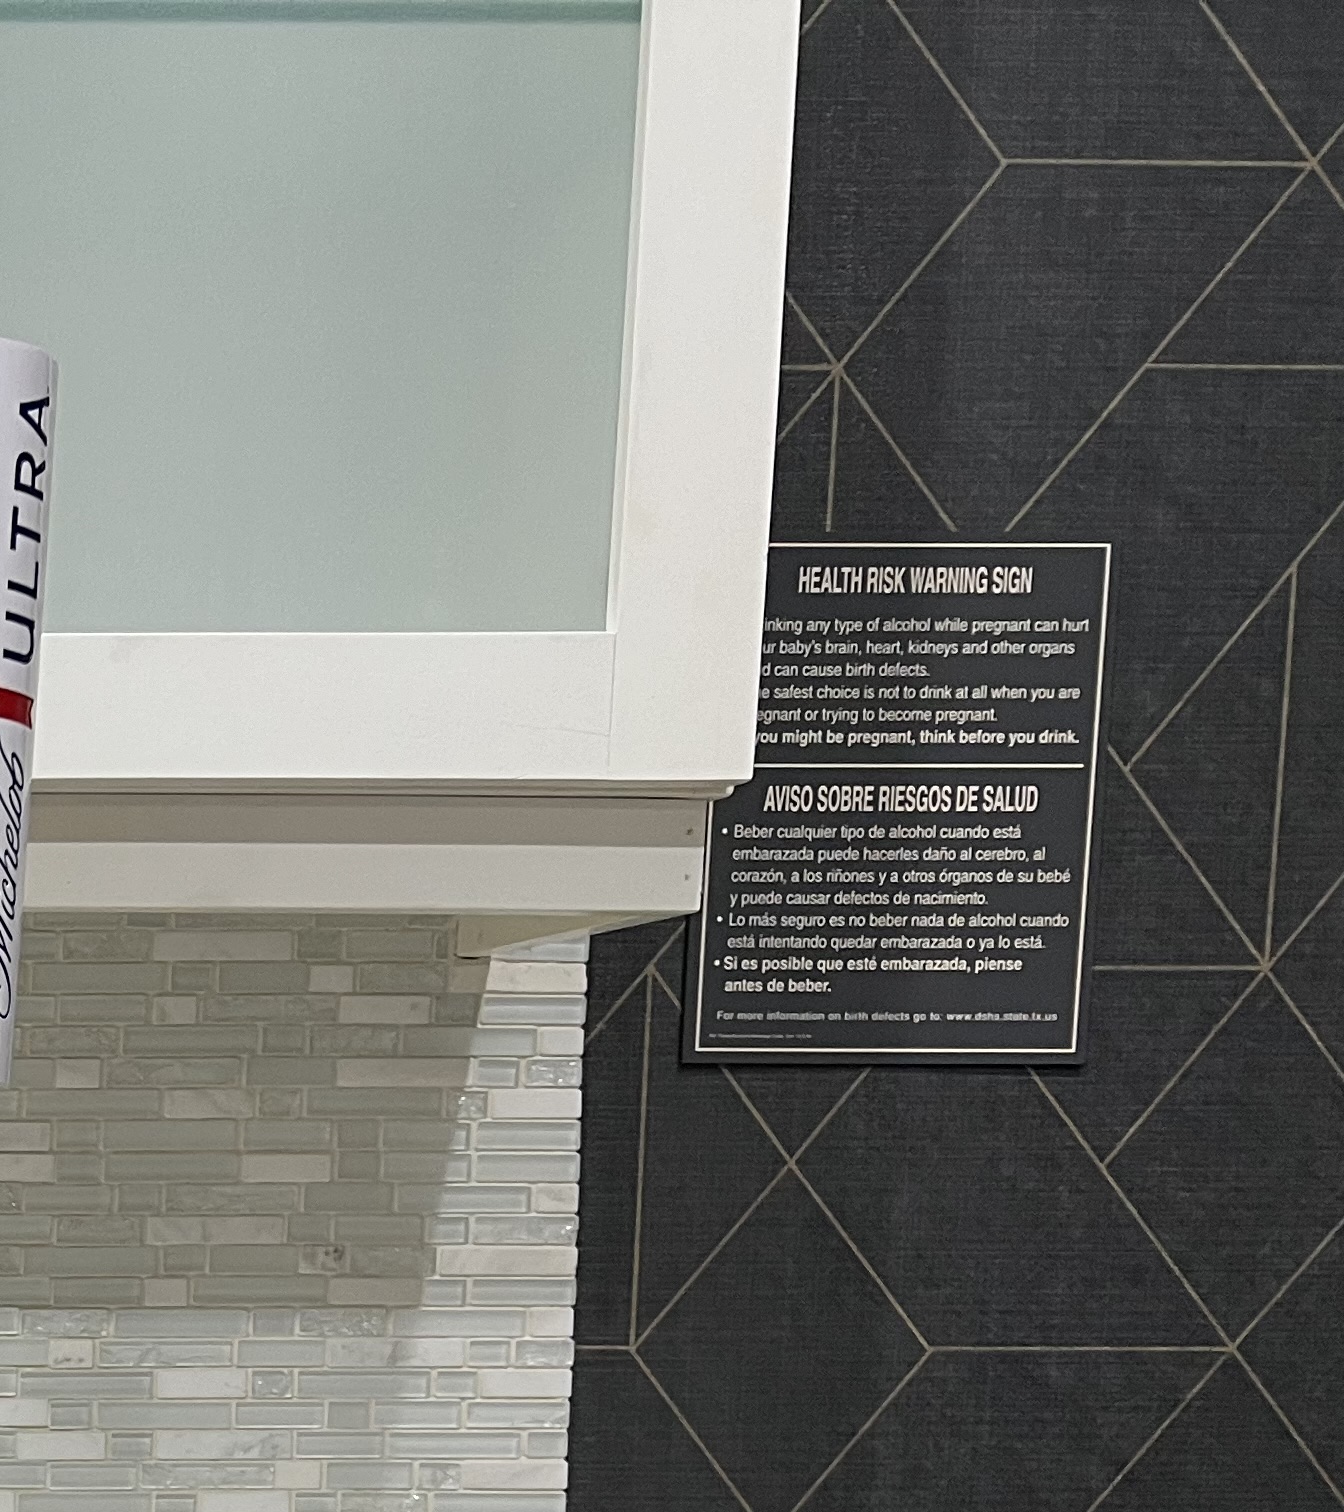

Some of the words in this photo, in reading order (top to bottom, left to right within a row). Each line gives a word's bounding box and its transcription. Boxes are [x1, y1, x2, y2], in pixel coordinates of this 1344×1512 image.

[2, 395, 51, 666] ULTRA
[798, 566, 862, 593] HEALTH
[866, 567, 906, 593] RISK
[910, 567, 988, 593] WARNING
[991, 567, 1033, 593] SIGN
[764, 618, 802, 635] inking
[806, 621, 831, 635] any
[834, 619, 863, 635] type
[866, 617, 880, 631] of
[882, 618, 931, 631] alcohol
[934, 618, 968, 631] while
[970, 619, 1031, 635] pregnant
[1033, 621, 1059, 631] can
[1061, 618, 1089, 632] hurt
[762, 643, 776, 653] ur
[778, 640, 821, 657] baby's
[824, 640, 861, 655] brain,
[865, 640, 903, 655] heart,
[907, 640, 958, 657] kidneys
[961, 640, 988, 654] and
[990, 640, 1026, 654] other
[1028, 643, 1075, 657] organs
[773, 666, 798, 676] can
[802, 666, 842, 676] cause
[845, 663, 875, 676] birth
[773, 685, 813, 698] safest
[816, 685, 860, 698] choice
[863, 685, 874, 698] is
[878, 686, 899, 699] not
[903, 686, 916, 699] to
[919, 685, 952, 698] drink
[954, 686, 968, 699] at
[971, 685, 987, 699] all
[990, 685, 1027, 698] when
[1030, 688, 1055, 702] you
[1057, 688, 1080, 699] are
[757, 708, 801, 724] egnant
[804, 710, 818, 721] or
[821, 708, 858, 724] trying
[862, 708, 875, 721] to
[878, 708, 932, 721] become
[934, 708, 997, 724] pregnant.
[781, 729, 822, 747] might
[825, 730, 844, 743] be
[847, 730, 915, 747] pregnant,
[919, 730, 955, 743] think
[958, 730, 1005, 743] before
[1007, 733, 1035, 747] you
[1038, 730, 1079, 743] drink.
[762, 785, 813, 812] AVISO
[816, 785, 874, 812] SOBRE
[878, 785, 952, 812] RIESGOS
[955, 786, 979, 811] DE
[981, 786, 1038, 812] SALUD
[733, 824, 774, 838] Beber
[776, 825, 837, 841] cualquier
[840, 825, 864, 842] tipo
[868, 825, 885, 838] de
[888, 825, 936, 838] alcohol
[939, 825, 989, 838] cuando
[992, 824, 1021, 838] está
[732, 846, 814, 860] embarazada
[817, 846, 859, 863] puede
[862, 847, 919, 860] hacerles
[922, 847, 956, 860] daño
[959, 847, 972, 860] al
[974, 847, 1029, 862] cerebro,
[1032, 847, 1045, 860] al
[730, 868, 786, 884] corazón,
[790, 872, 799, 882] a
[802, 869, 822, 882] los
[826, 869, 874, 882] riñones
[878, 872, 887, 885] y
[889, 872, 898, 882] a
[902, 870, 935, 882] otros
[938, 868, 993, 886] órganos
[996, 869, 1013, 882] de
[1016, 872, 1034, 882] su
[1036, 868, 1070, 882] bebé
[729, 894, 738, 907] y
[740, 891, 782, 907] puede
[785, 894, 831, 904] causar
[833, 891, 889, 904] defectos
[892, 891, 910, 904] de
[913, 891, 988, 904] nacimiento.
[728, 913, 745, 926] Lo
[748, 912, 777, 926] más
[780, 916, 826, 930] seguro
[828, 916, 845, 926] es
[848, 916, 865, 926] no
[869, 913, 908, 926] beber
[910, 913, 944, 926] nada
[947, 913, 965, 926] de
[968, 913, 1016, 927] alcohol
[1019, 914, 1069, 927] cuando
[727, 934, 755, 948] está
[758, 934, 827, 948] intentando
[830, 935, 877, 952] quedar
[880, 935, 962, 948] embarazada
[965, 938, 975, 948] o
[978, 938, 994, 952] ya
[997, 935, 1010, 948] lo
[1013, 935, 1046, 948] está.
[723, 956, 737, 970] Si
[740, 960, 757, 970] es
[761, 957, 813, 973] posible
[816, 960, 843, 973] que
[846, 956, 877, 970] esté
[880, 957, 970, 973] embarazada,
[974, 957, 1022, 974] piense
[724, 979, 763, 991] antes
[766, 978, 784, 992] de
[787, 979, 831, 992] beber.
